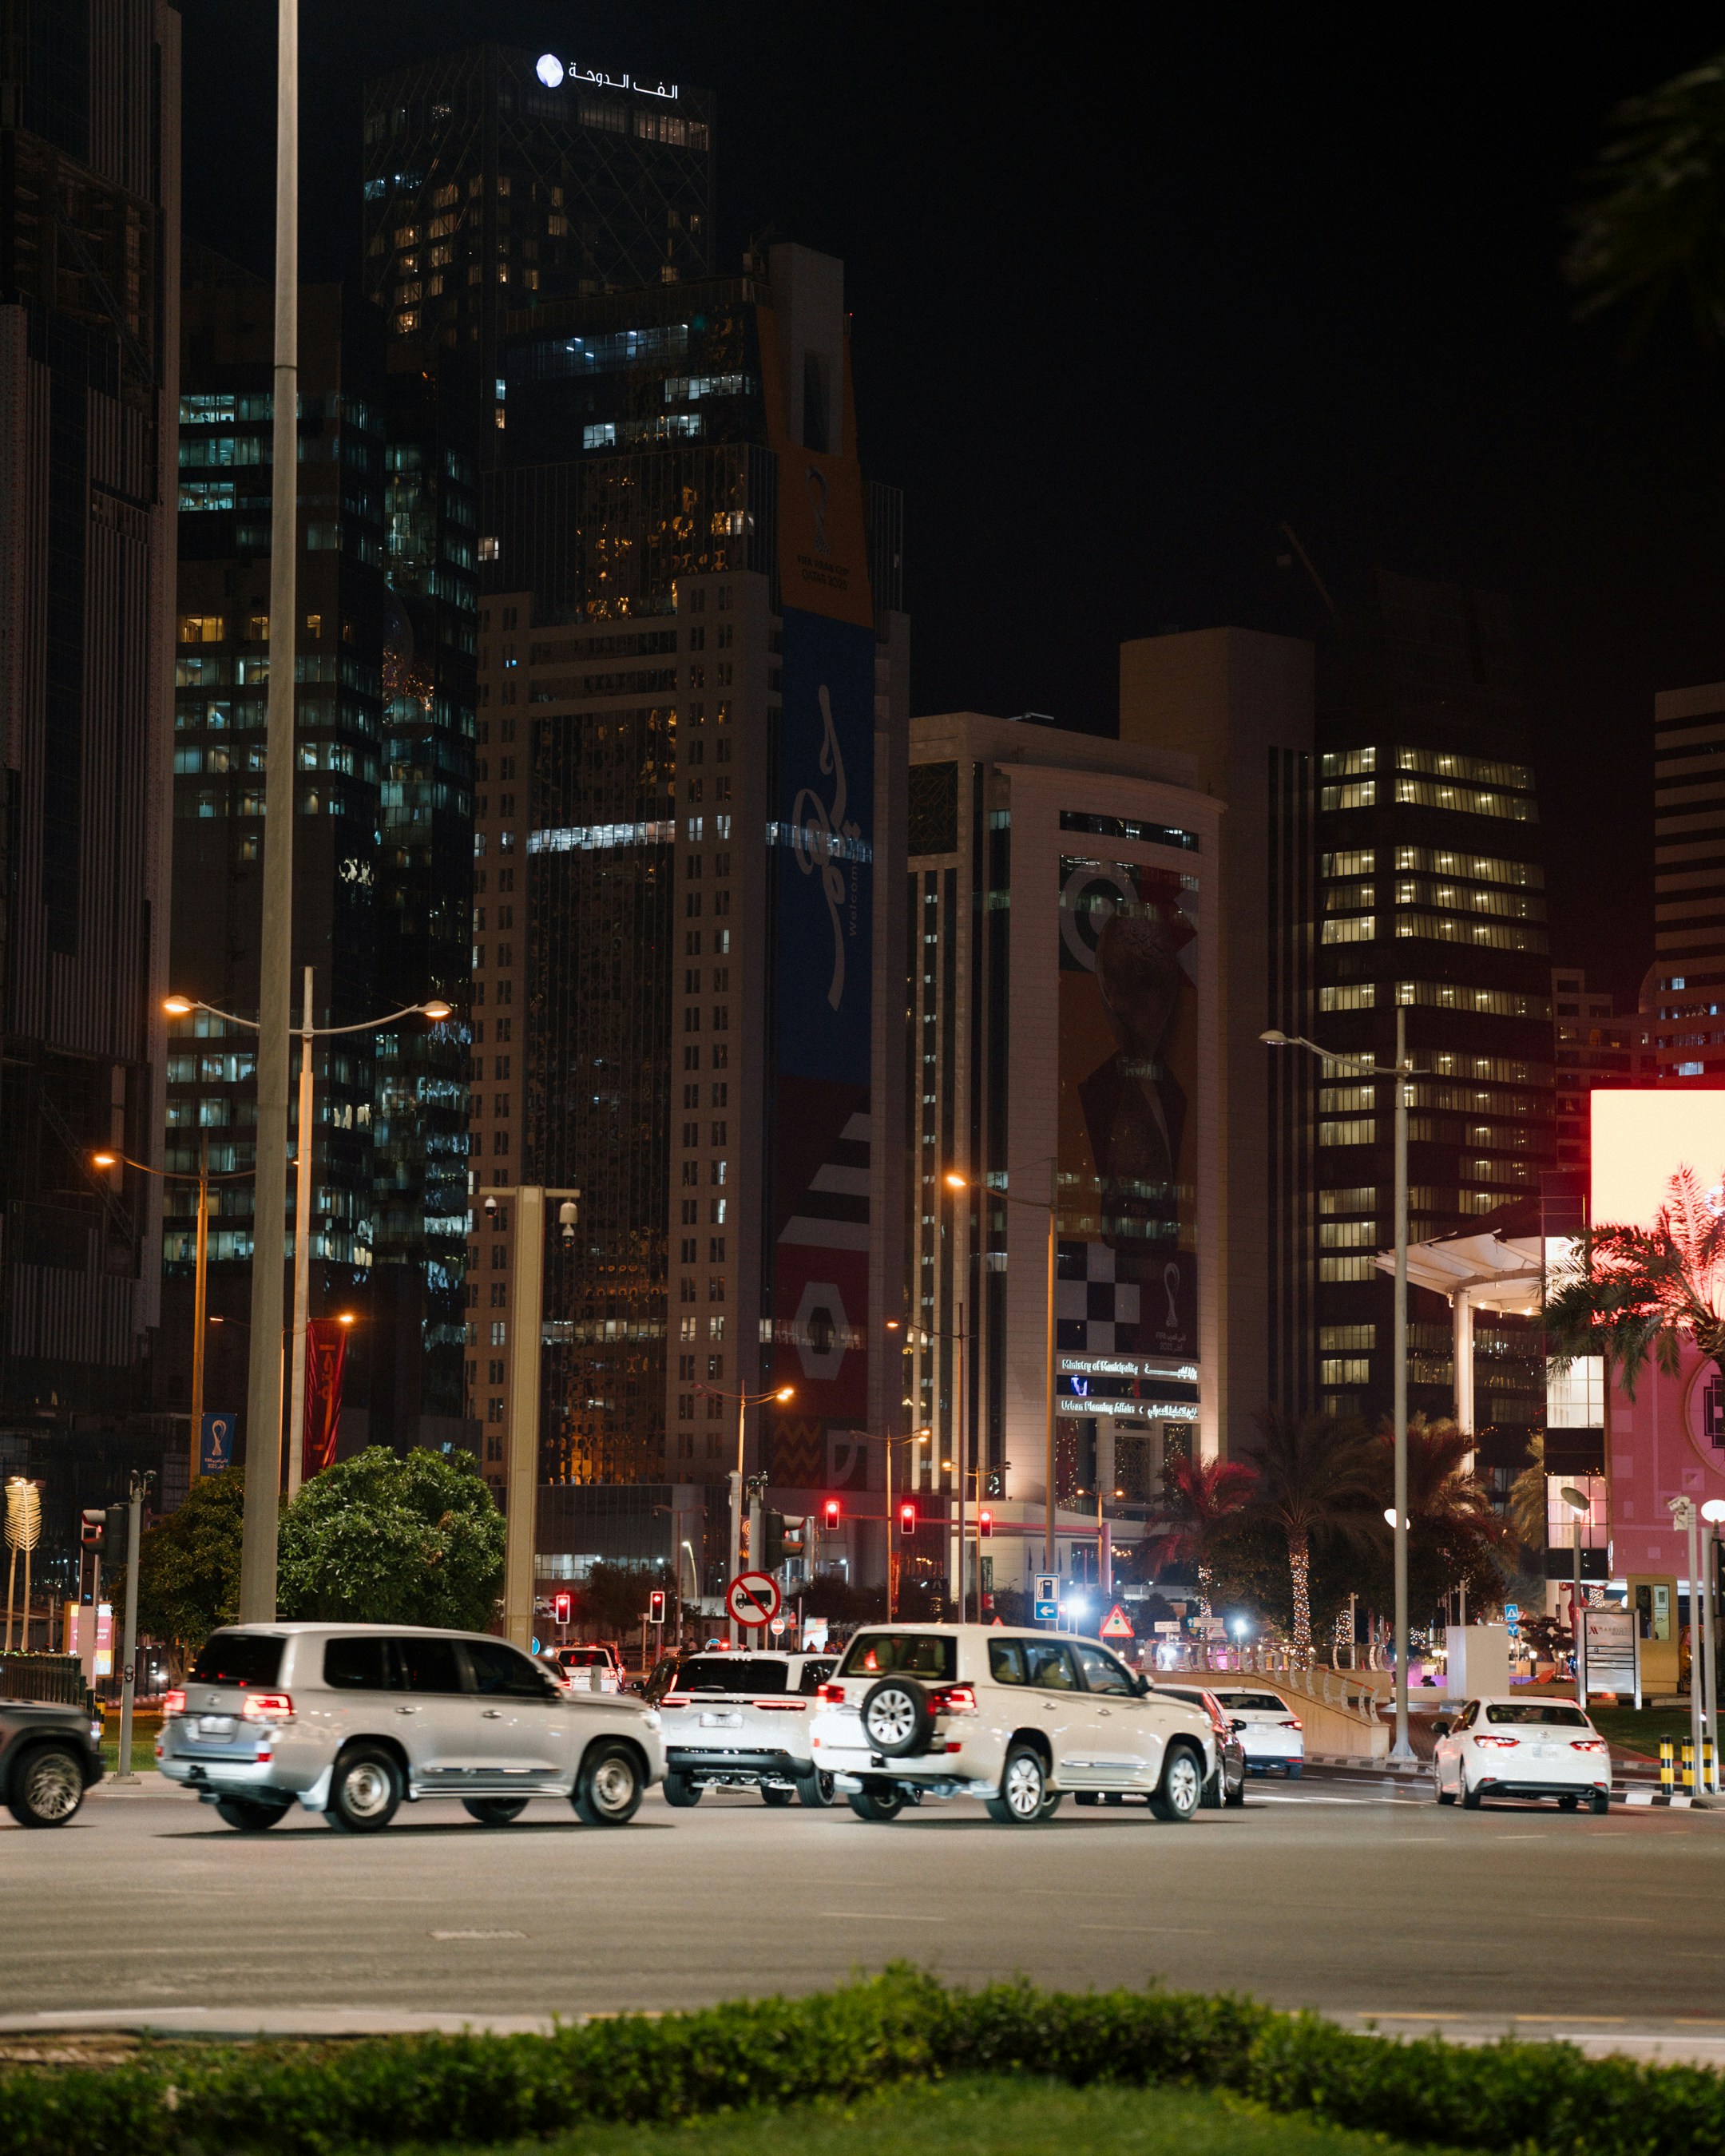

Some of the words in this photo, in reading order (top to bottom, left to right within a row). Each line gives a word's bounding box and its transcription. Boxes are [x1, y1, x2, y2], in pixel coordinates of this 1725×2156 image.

[569, 61, 629, 89] الدوحة
[802, 569, 826, 584] QATAR
[827, 575, 848, 590] 2025
[1062, 1359, 1092, 1373] Ministry
[1092, 1360, 1100, 1371] of
[1100, 1361, 1139, 1375] Municipality
[1061, 1400, 1084, 1411] Urban
[1084, 1401, 1114, 1415] Planning
[1114, 1402, 1136, 1413] Affairs
